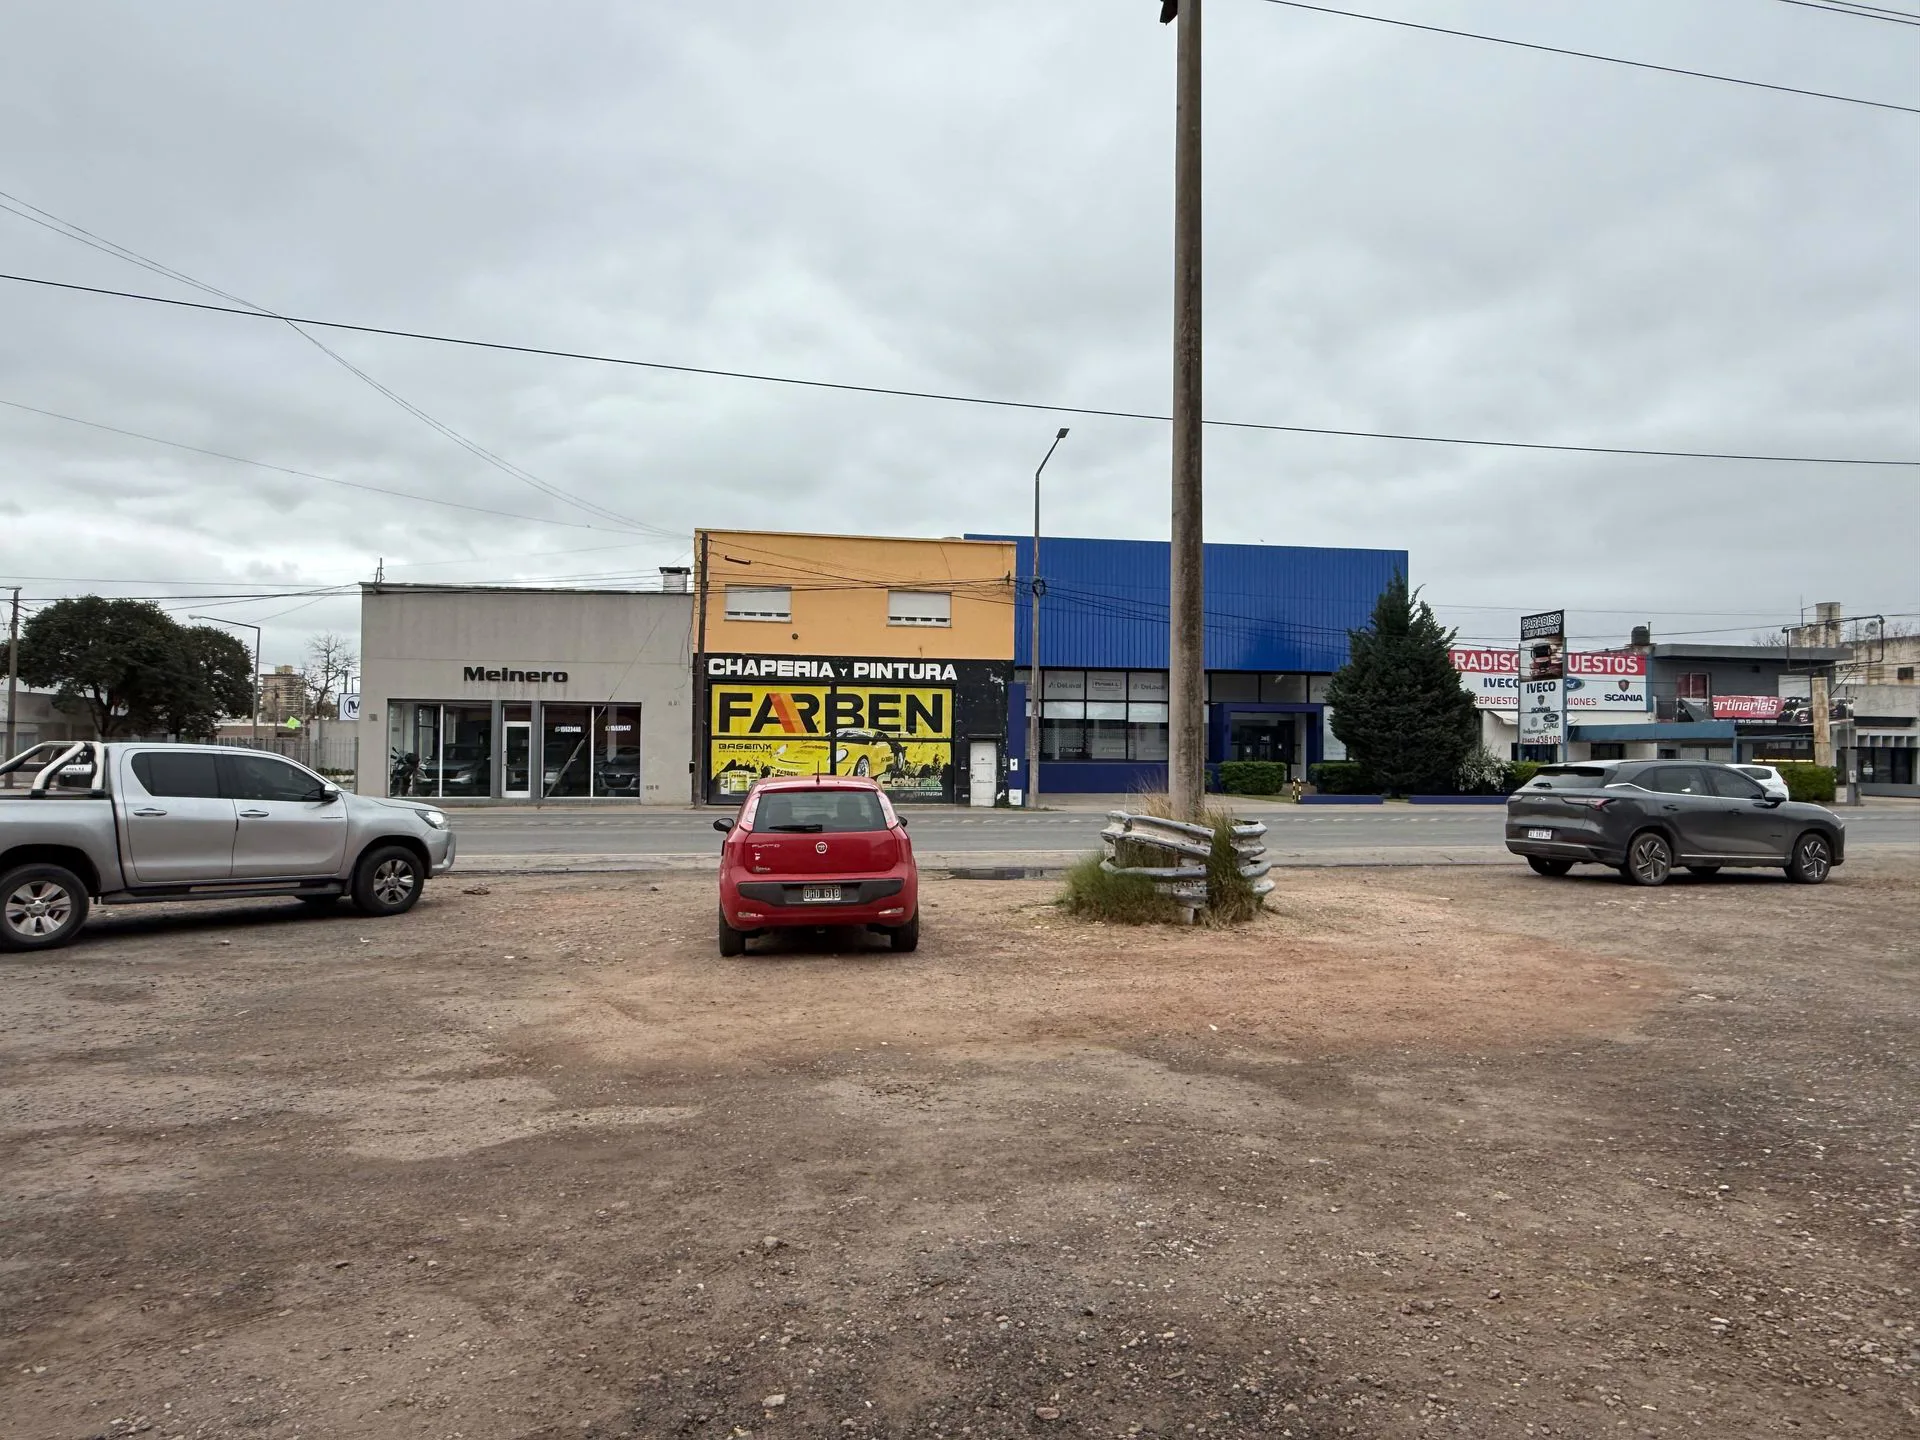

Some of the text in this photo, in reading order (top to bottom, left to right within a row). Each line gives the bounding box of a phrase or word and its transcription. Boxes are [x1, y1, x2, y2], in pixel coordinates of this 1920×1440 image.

[1522, 613, 1561, 630] PARADISO
[463, 666, 568, 683] Meinero
[708, 658, 958, 680] CHAPERIA Y PINTURA
[1526, 681, 1557, 694] IVECO
[1604, 693, 1643, 702] SCANIA
[718, 692, 943, 734] FARBEN
